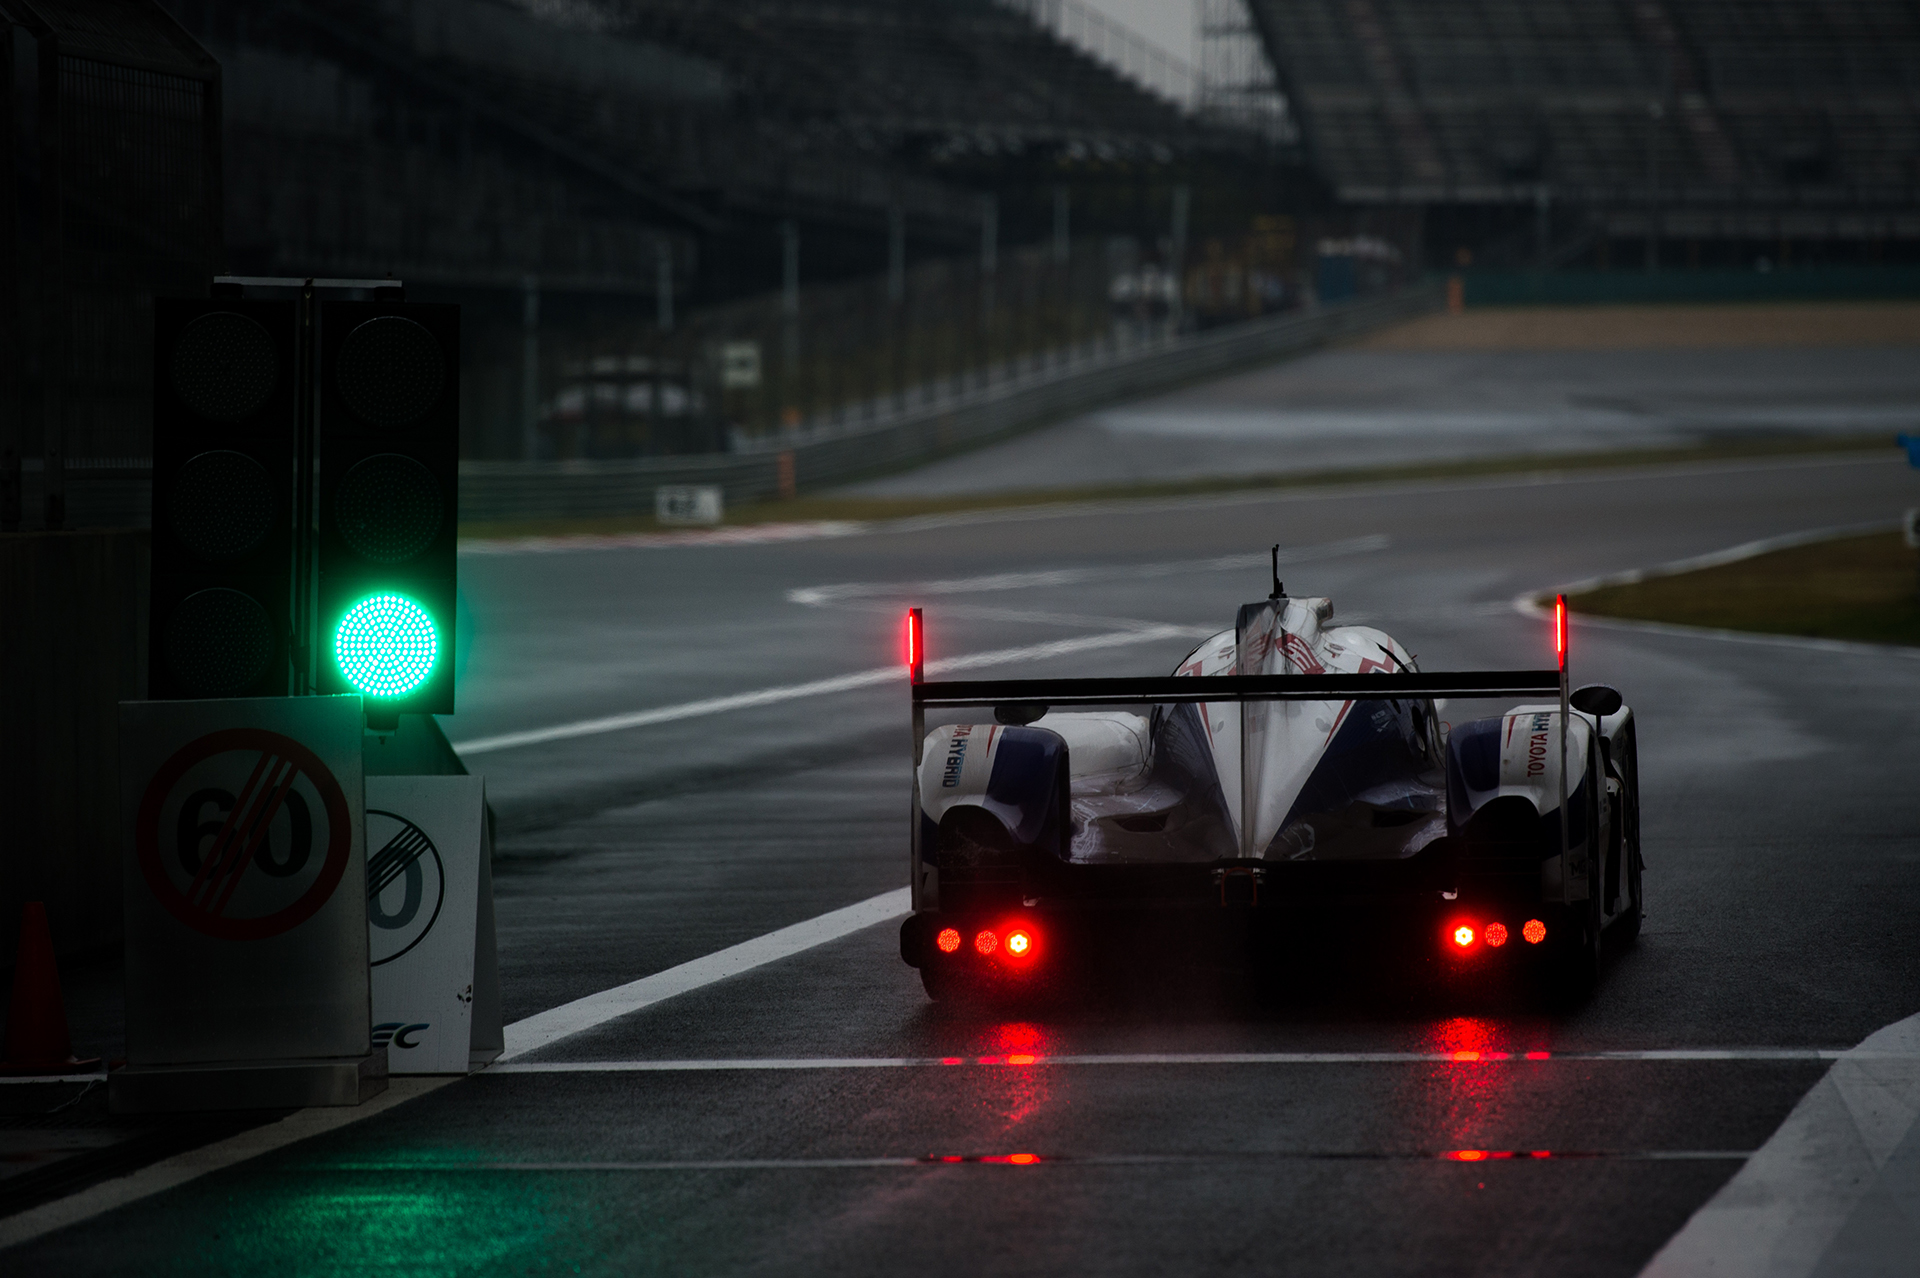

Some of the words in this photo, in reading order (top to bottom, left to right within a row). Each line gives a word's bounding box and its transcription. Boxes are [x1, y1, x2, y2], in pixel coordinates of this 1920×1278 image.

[943, 739, 968, 787] HYBRID
[1527, 733, 1548, 777] TOYOTA
[177, 786, 312, 880] 60
